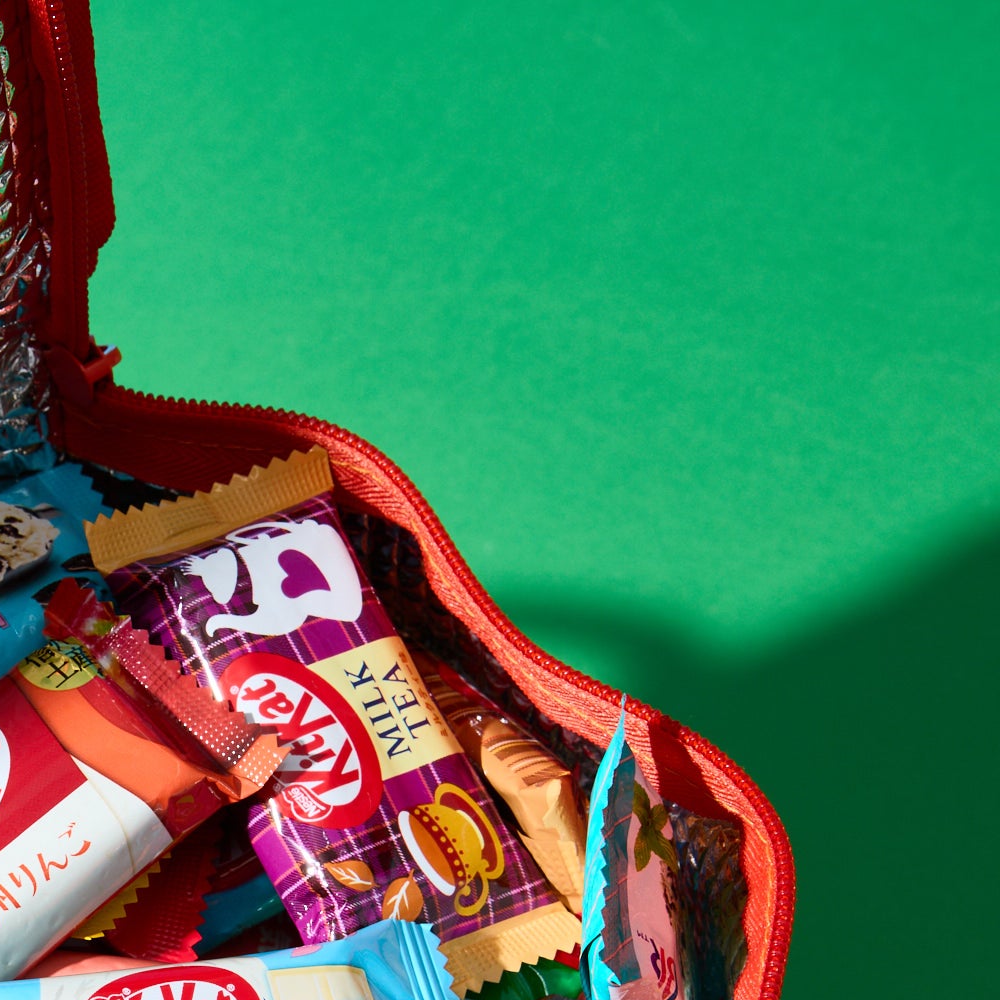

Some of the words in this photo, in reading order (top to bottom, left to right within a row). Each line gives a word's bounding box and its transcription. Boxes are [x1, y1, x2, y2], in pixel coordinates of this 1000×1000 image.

[241, 678, 360, 796] KitKat
[343, 660, 413, 760] MILK
[381, 661, 431, 740] TEA
